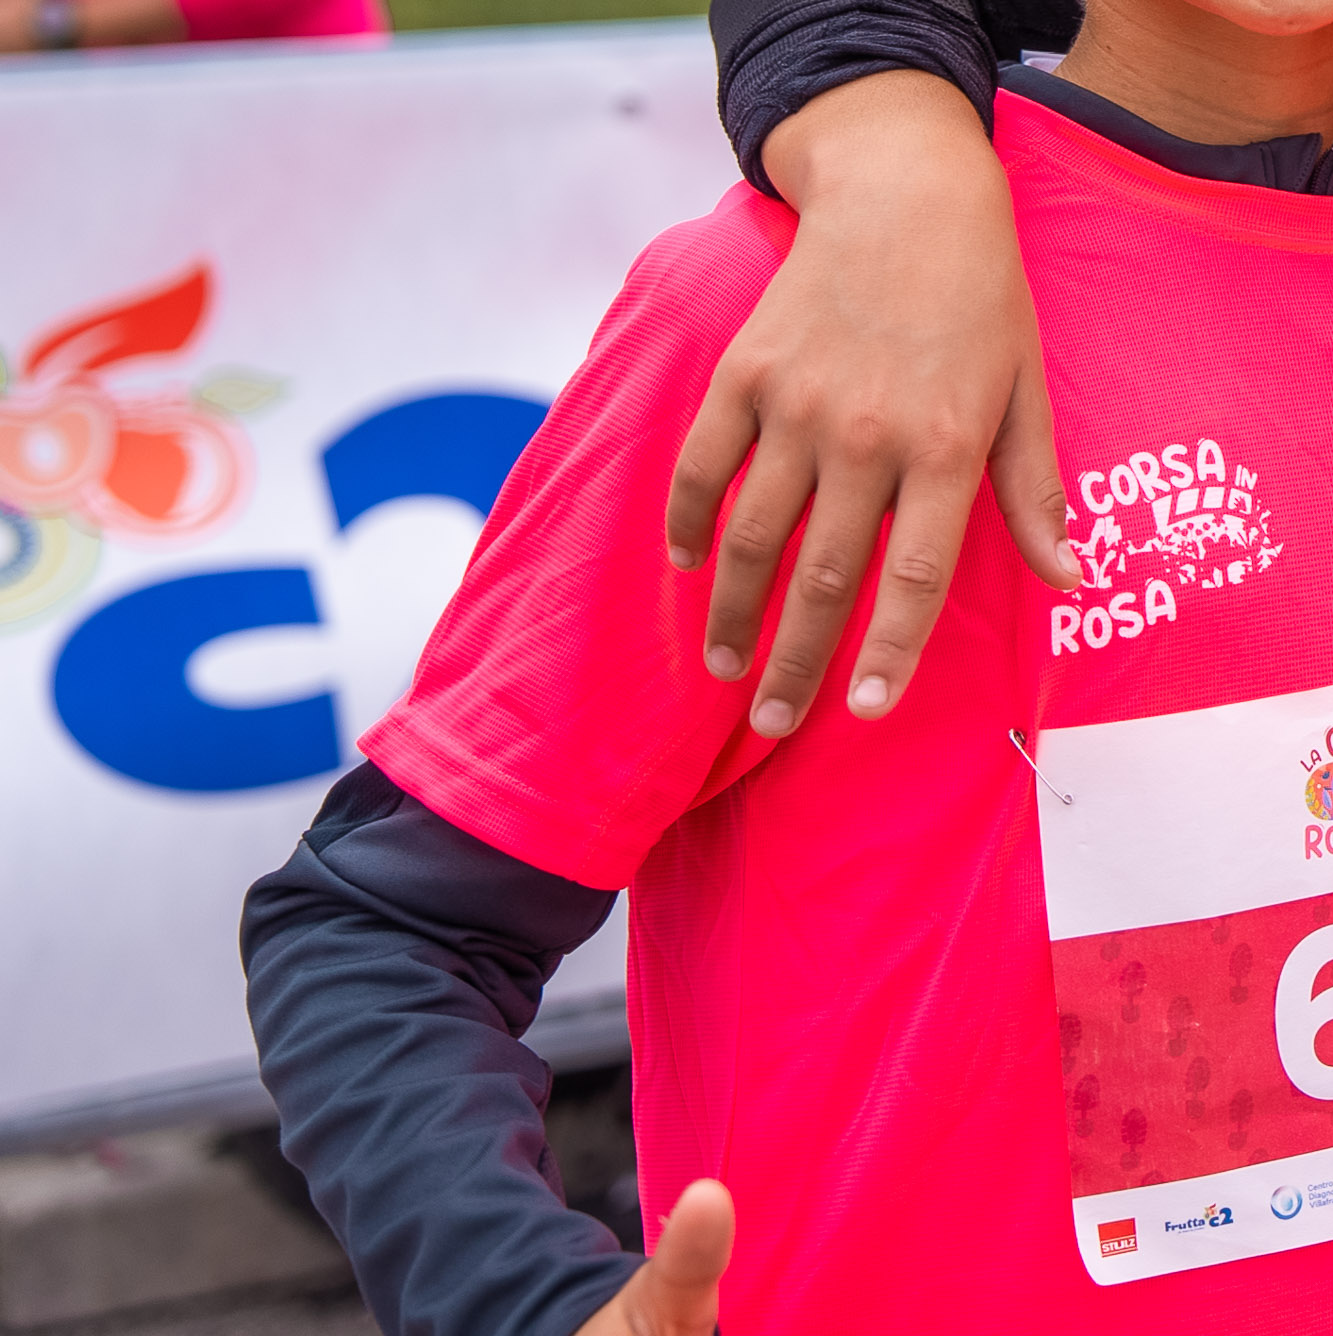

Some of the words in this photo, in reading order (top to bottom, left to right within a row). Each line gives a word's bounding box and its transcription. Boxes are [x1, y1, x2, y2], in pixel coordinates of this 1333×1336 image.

[1079, 438, 1226, 515] CORSA
[1235, 465, 1258, 490] IN
[1051, 578, 1177, 656] ROSA
[1300, 749, 1322, 772] LA
[1307, 1180, 1333, 1191] Centro
[1165, 1218, 1205, 1232] Frutta
[1209, 1207, 1234, 1227] c2
